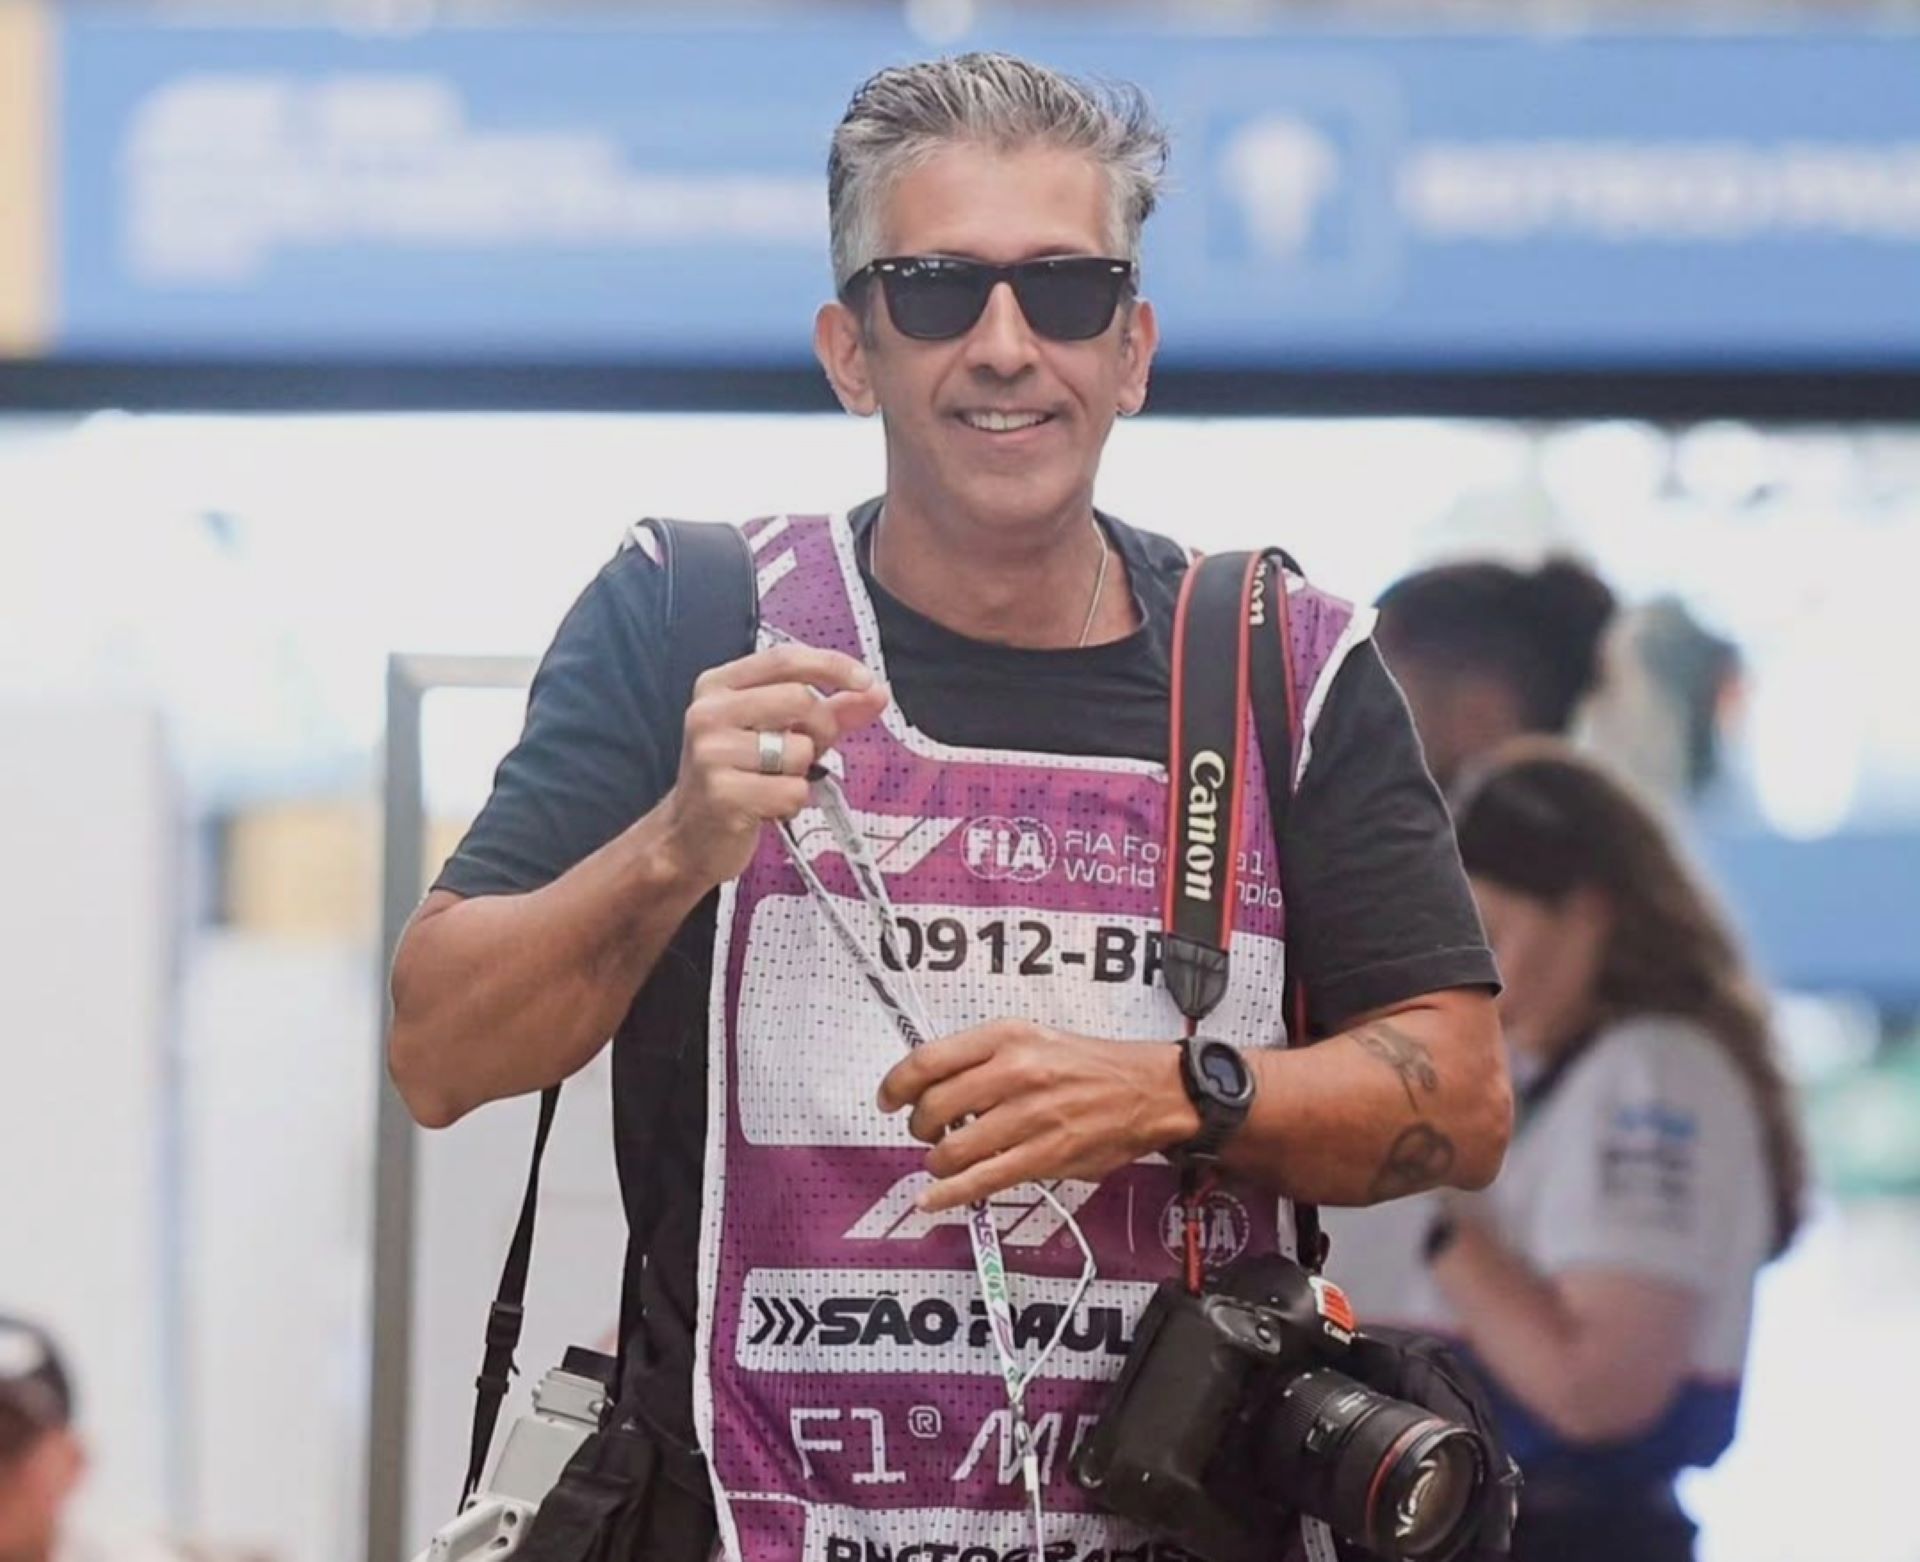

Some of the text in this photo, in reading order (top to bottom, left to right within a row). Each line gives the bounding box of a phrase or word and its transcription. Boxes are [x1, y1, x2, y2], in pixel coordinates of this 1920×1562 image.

[1065, 829, 1116, 856] FIA
[1185, 750, 1226, 902] Canon
[967, 827, 1047, 870] FIA
[1064, 857, 1155, 889] World
[817, 1289, 1138, 1356] SÃO PAUL
